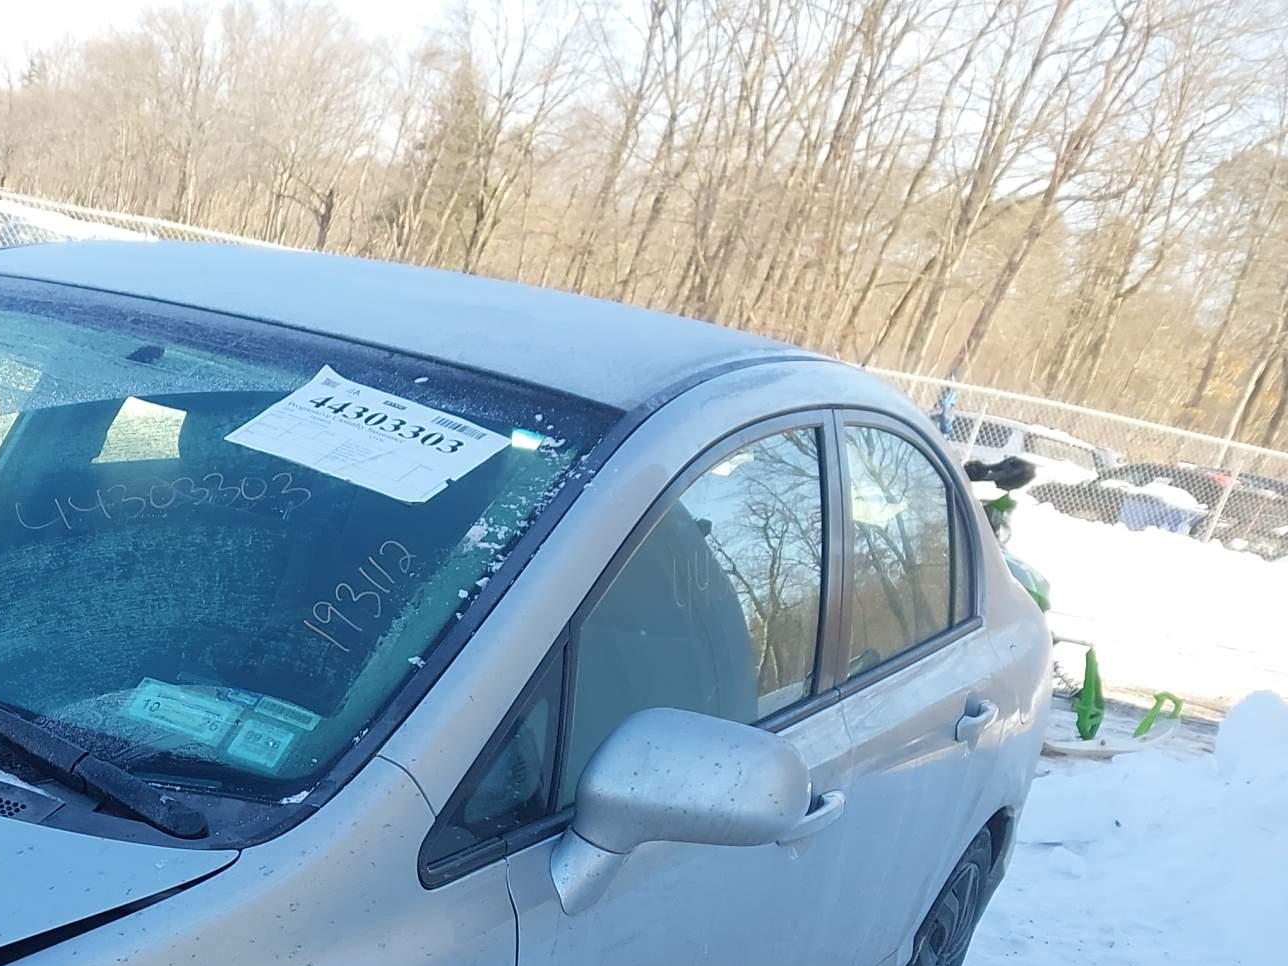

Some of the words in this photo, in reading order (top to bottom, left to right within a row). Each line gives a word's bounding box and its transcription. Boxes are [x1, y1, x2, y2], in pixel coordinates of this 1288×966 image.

[309, 395, 465, 454] 44303303
[15, 472, 312, 530] 44303303
[303, 539, 417, 652] 193112
[144, 698, 161, 712] 10
